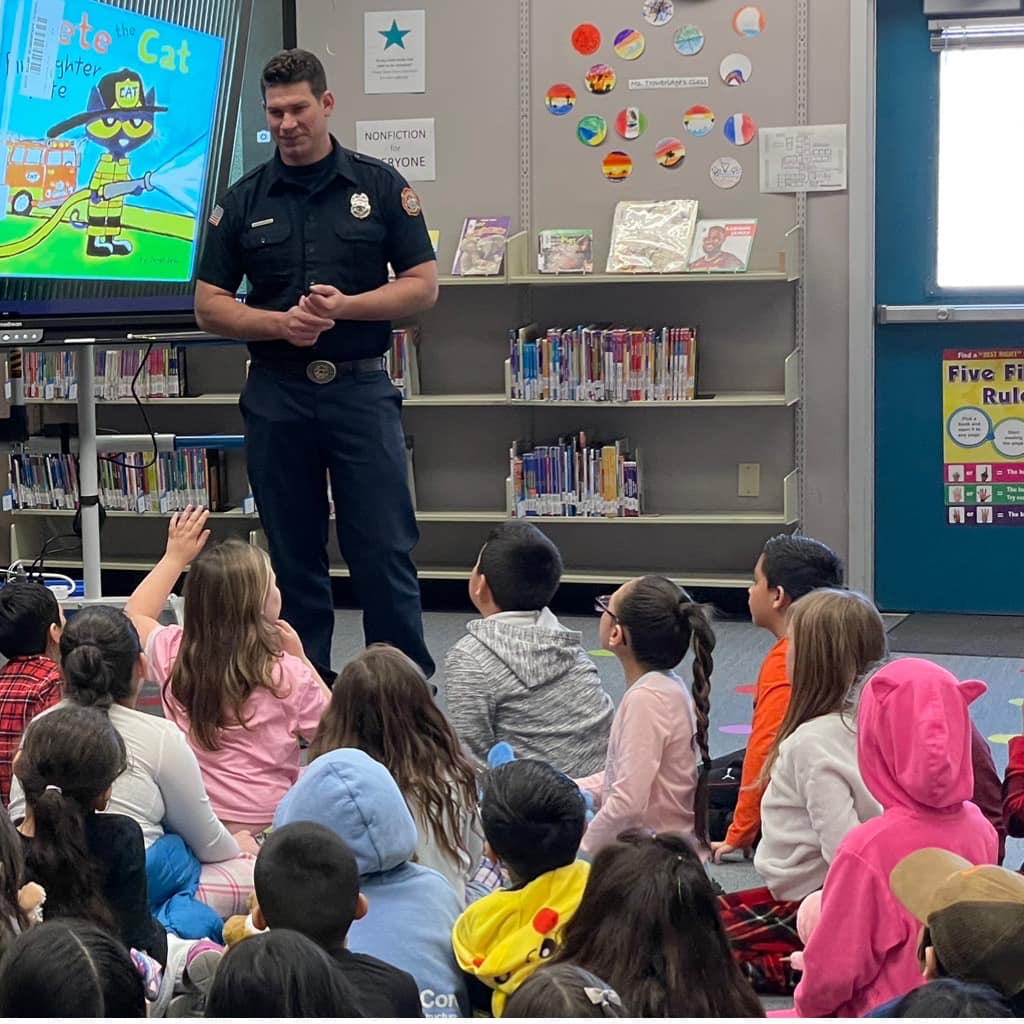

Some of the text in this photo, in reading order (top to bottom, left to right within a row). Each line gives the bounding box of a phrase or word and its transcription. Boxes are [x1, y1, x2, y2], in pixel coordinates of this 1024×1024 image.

[59, 12, 112, 54] ete
[115, 23, 136, 39] the
[137, 28, 192, 74] Cat
[119, 86, 139, 98] CAT
[365, 130, 426, 141] NONFICTION
[949, 365, 994, 382] Five
